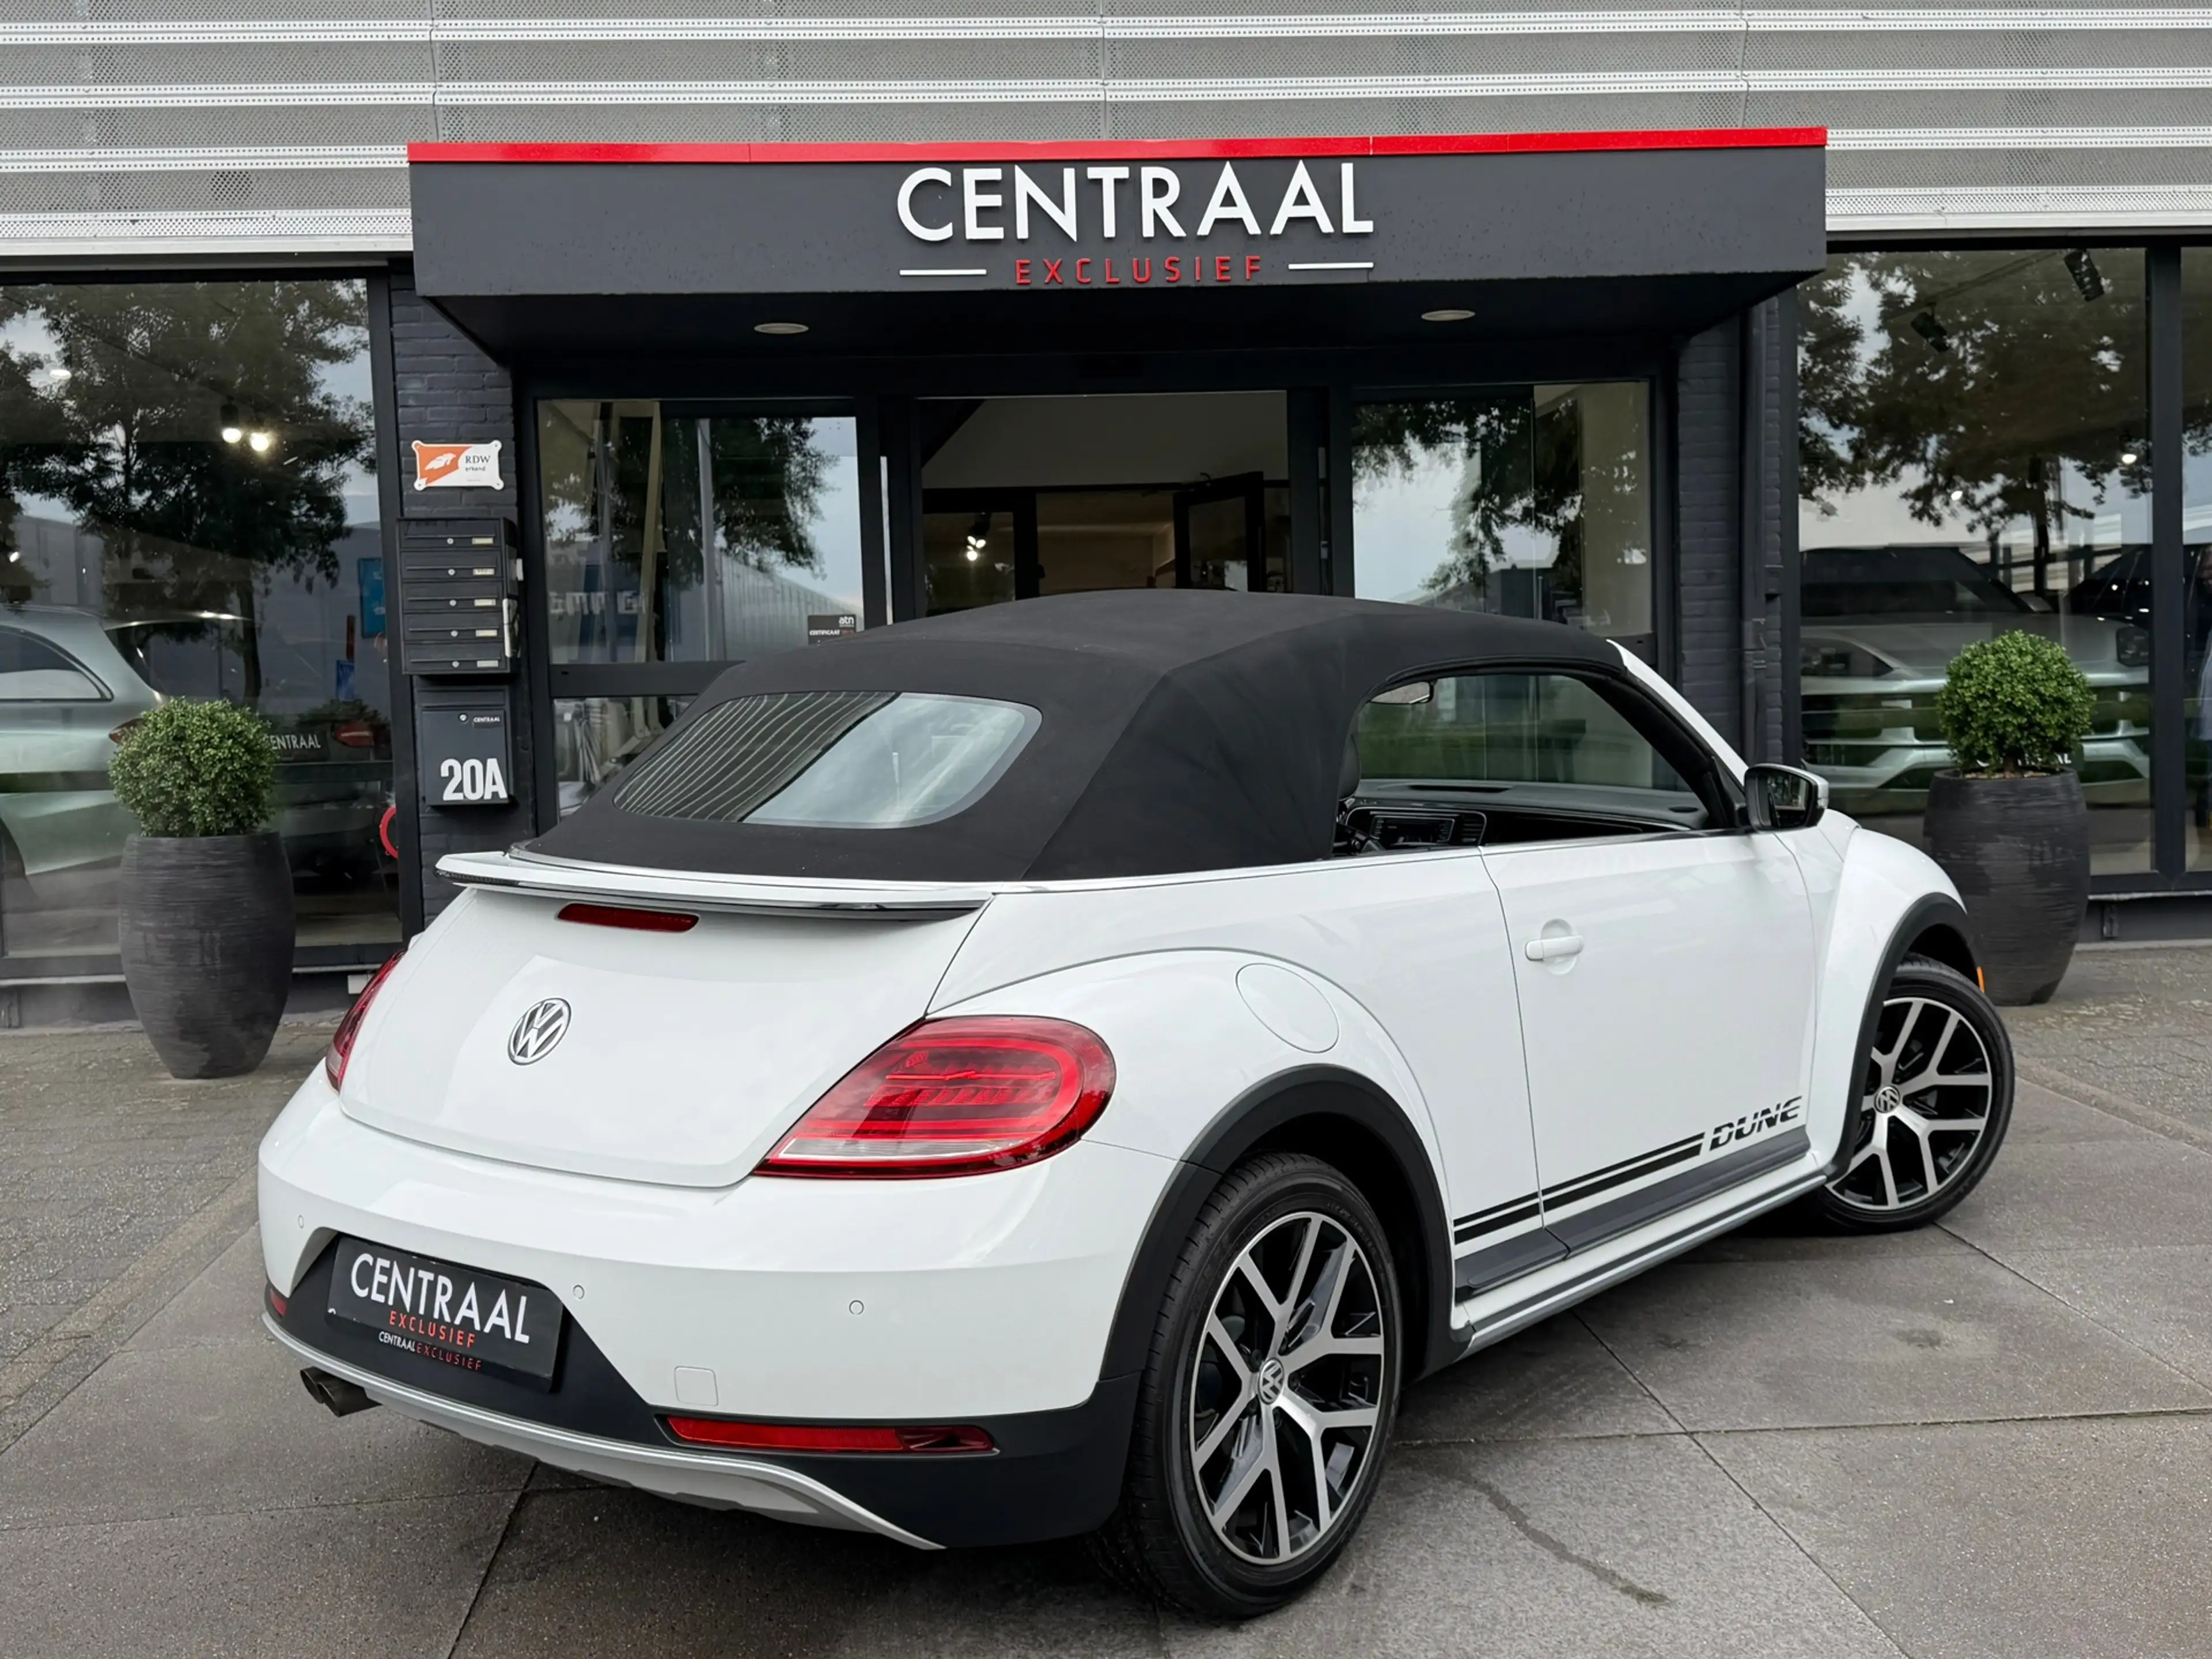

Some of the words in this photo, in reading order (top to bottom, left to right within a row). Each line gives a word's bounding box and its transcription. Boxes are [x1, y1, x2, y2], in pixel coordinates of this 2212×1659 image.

[897, 160, 1374, 242] CENTRAAL
[1016, 255, 1264, 286] EXCLUSIEF
[465, 455, 490, 464] RDW
[267, 733, 321, 749] ENTRAAL
[440, 758, 508, 801] 20A
[1709, 1096, 1802, 1152] DUNE
[350, 1252, 530, 1343] CENTRAAL
[388, 1310, 476, 1348] EXCLUSIEF
